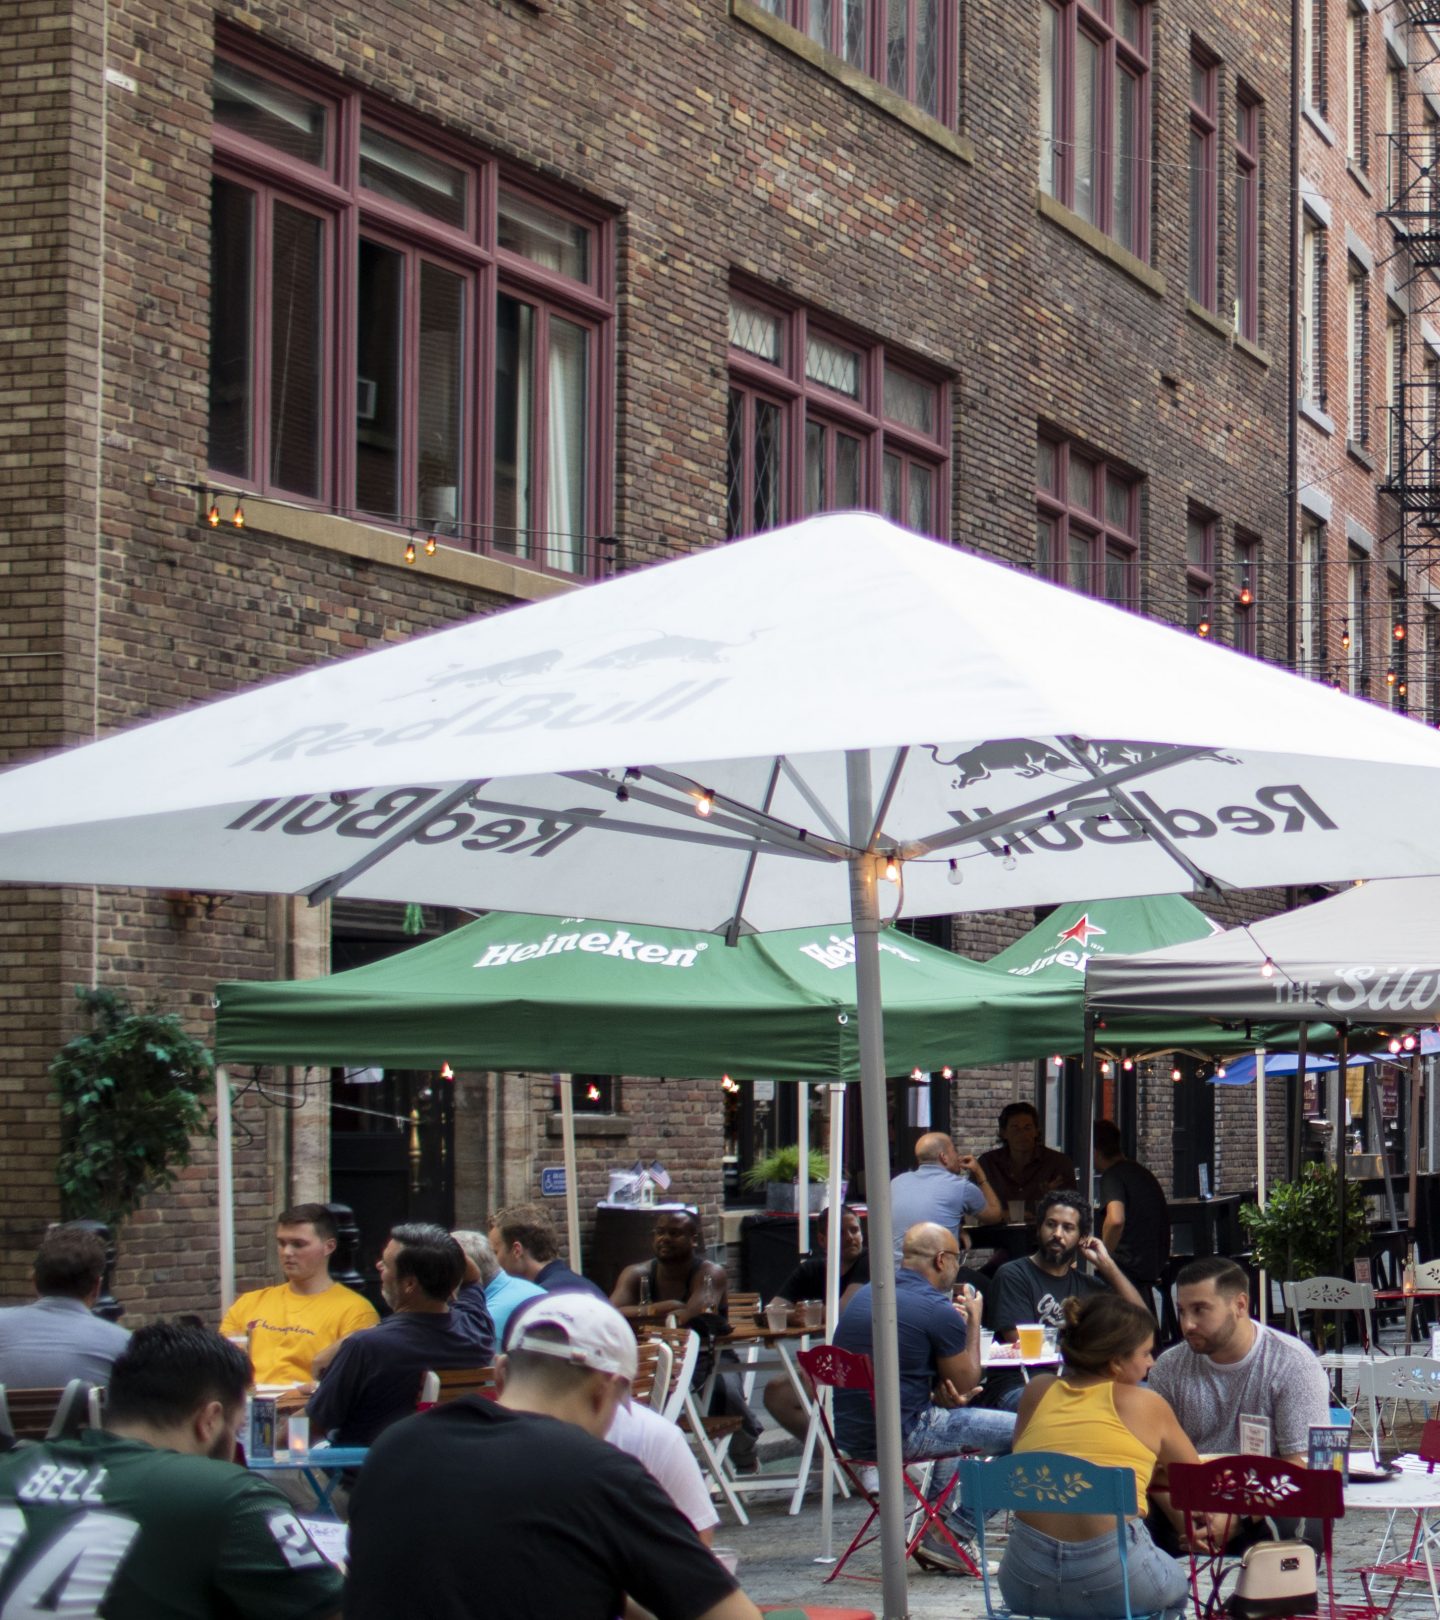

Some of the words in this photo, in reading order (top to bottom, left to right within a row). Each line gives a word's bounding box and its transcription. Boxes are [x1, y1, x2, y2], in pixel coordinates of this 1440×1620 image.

[228, 696, 500, 767] Red
[456, 677, 733, 736] Bull
[473, 930, 698, 968] Heineken
[1273, 981, 1321, 1004] THE
[1311, 1434, 1349, 1448] AWAITS
[18, 1464, 108, 1501] BELL
